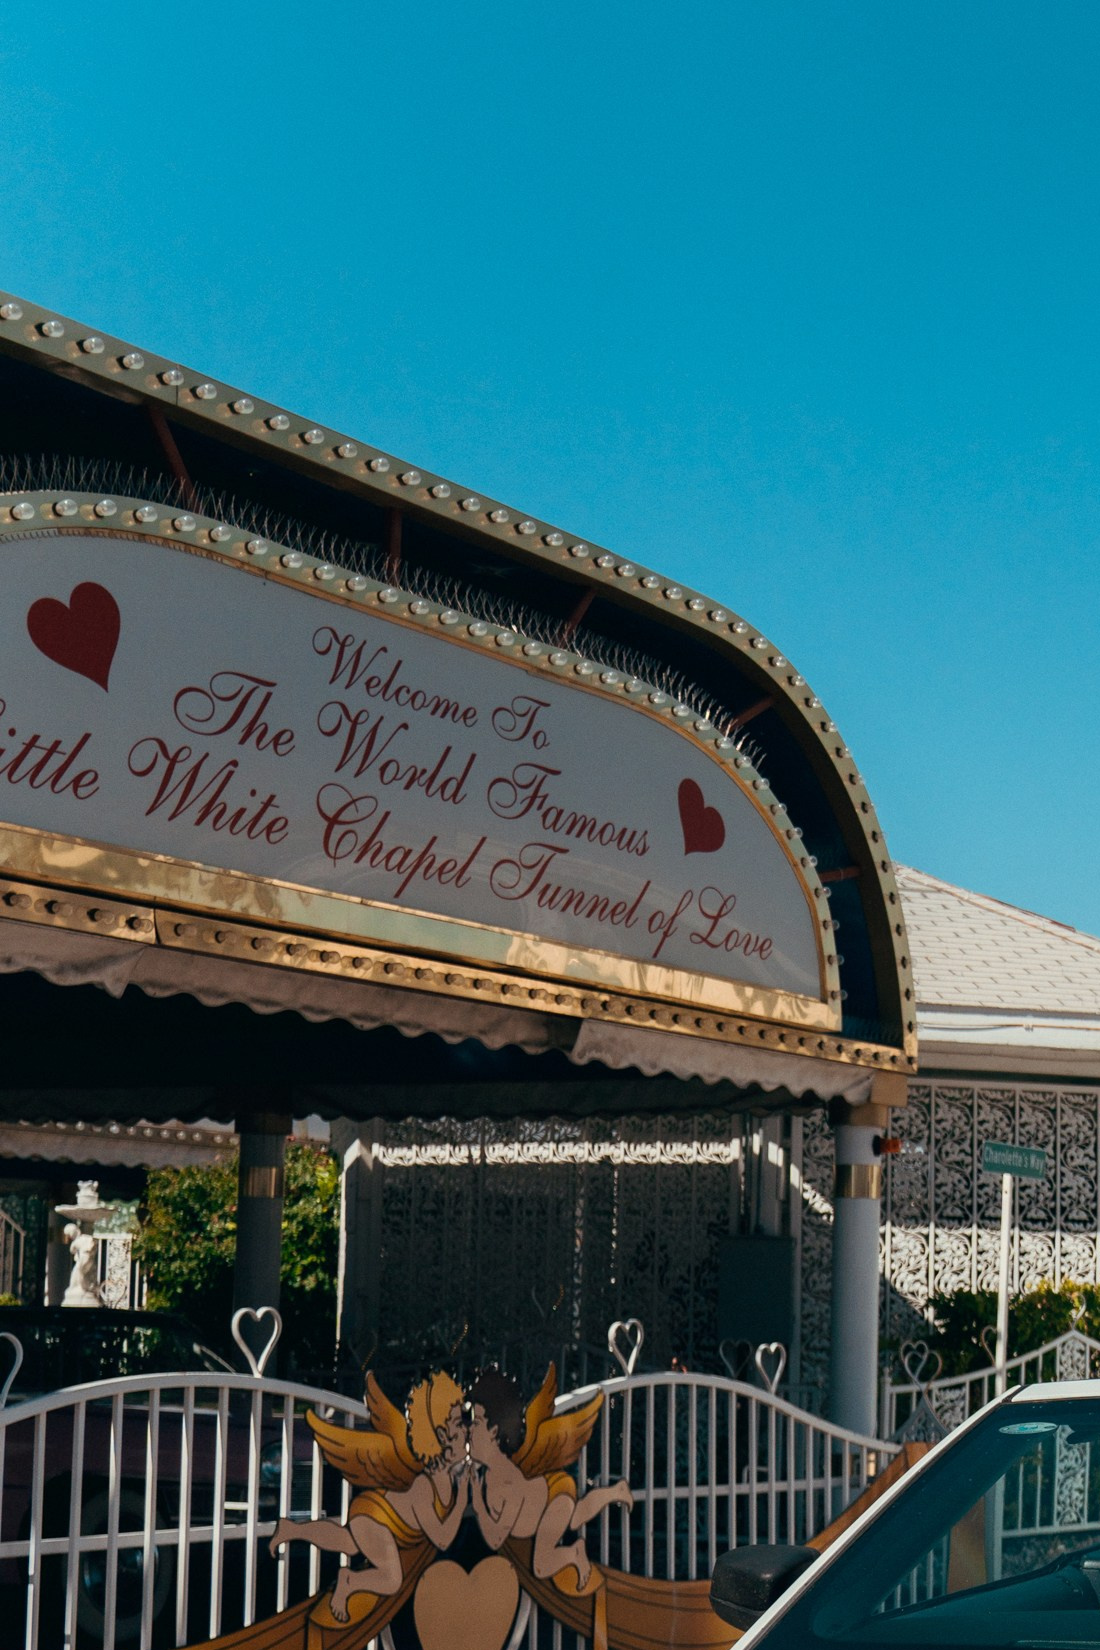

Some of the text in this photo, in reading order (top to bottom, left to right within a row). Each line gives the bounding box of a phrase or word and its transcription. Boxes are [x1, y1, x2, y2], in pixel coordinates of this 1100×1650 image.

[173, 671, 650, 857] The World Famous
[312, 626, 551, 750] Welcome To
[0, 698, 774, 961] ittle White Chapel Tunnel of Love
